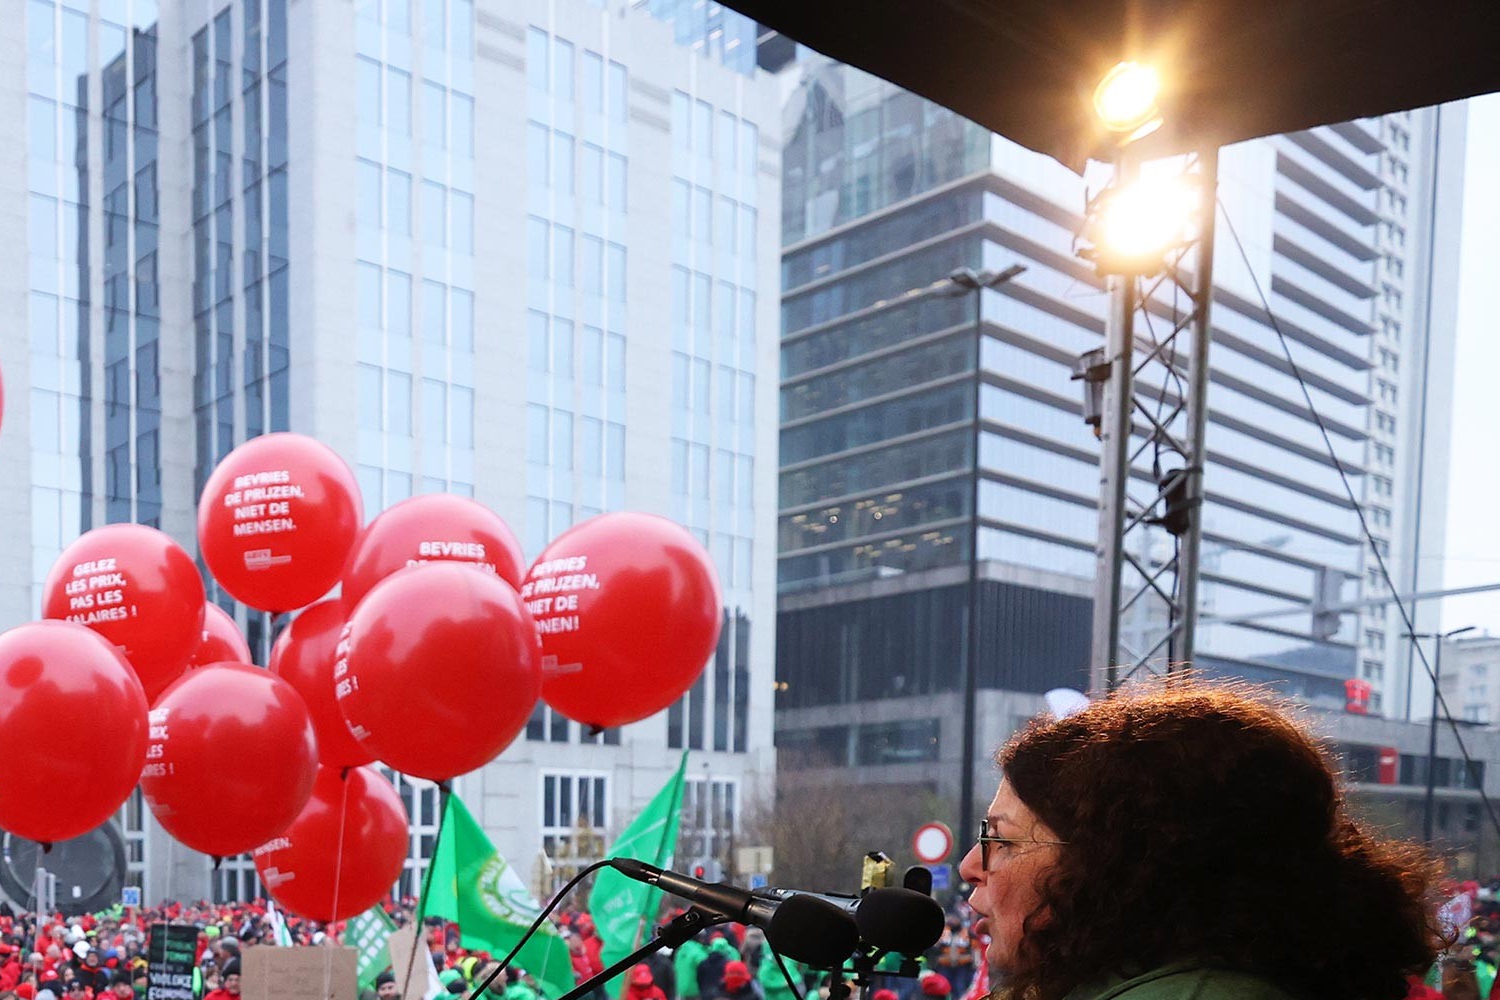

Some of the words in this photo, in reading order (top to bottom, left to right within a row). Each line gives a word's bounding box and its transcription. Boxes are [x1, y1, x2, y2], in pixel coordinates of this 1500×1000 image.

[234, 470, 289, 489] BEVRIES
[224, 491, 242, 507] DE
[234, 503, 266, 519] NIET
[268, 501, 290, 516] DE
[233, 517, 297, 537] MENSEN.
[419, 541, 487, 559] BEVRIES
[73, 558, 117, 578] GELEZ
[531, 556, 588, 578] BEVRIES
[65, 578, 87, 595] LES
[89, 572, 127, 590] PRIX,
[534, 574, 601, 596] PRIJZEN,
[70, 594, 94, 610] PAS
[97, 589, 124, 606] LES
[555, 594, 579, 612] DE
